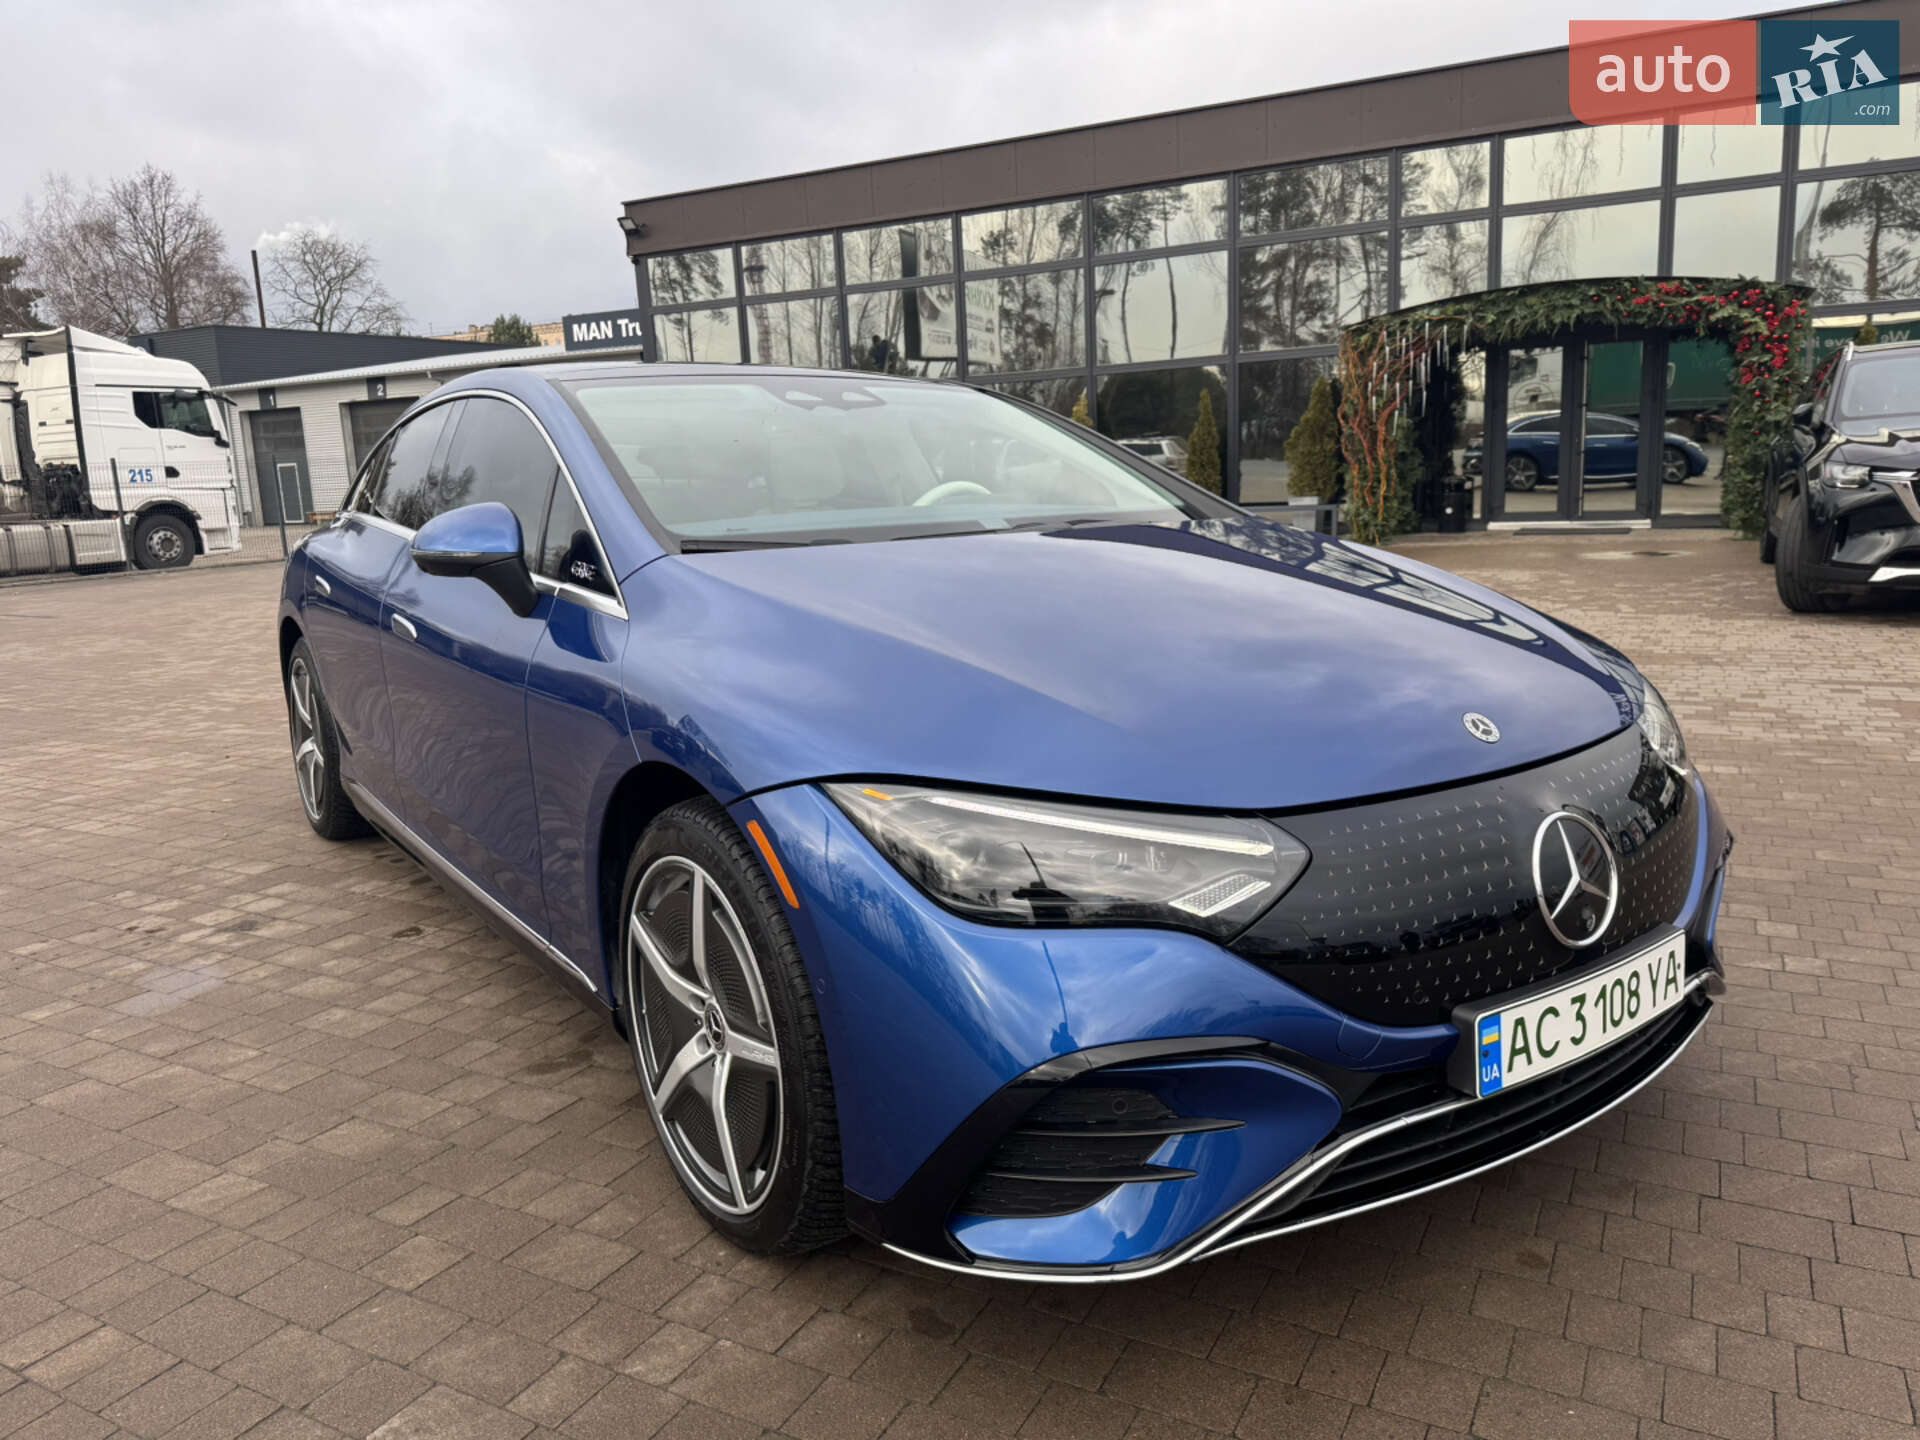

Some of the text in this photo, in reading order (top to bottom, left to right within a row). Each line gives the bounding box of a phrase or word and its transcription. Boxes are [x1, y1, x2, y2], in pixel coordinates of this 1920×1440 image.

[572, 320, 613, 342] MAN
[377, 384, 385, 396] 2
[269, 394, 275, 406] 1
[128, 468, 154, 483] 215
[1507, 950, 1679, 1073] AC 3108 YA
[1482, 1063, 1501, 1082] UA
